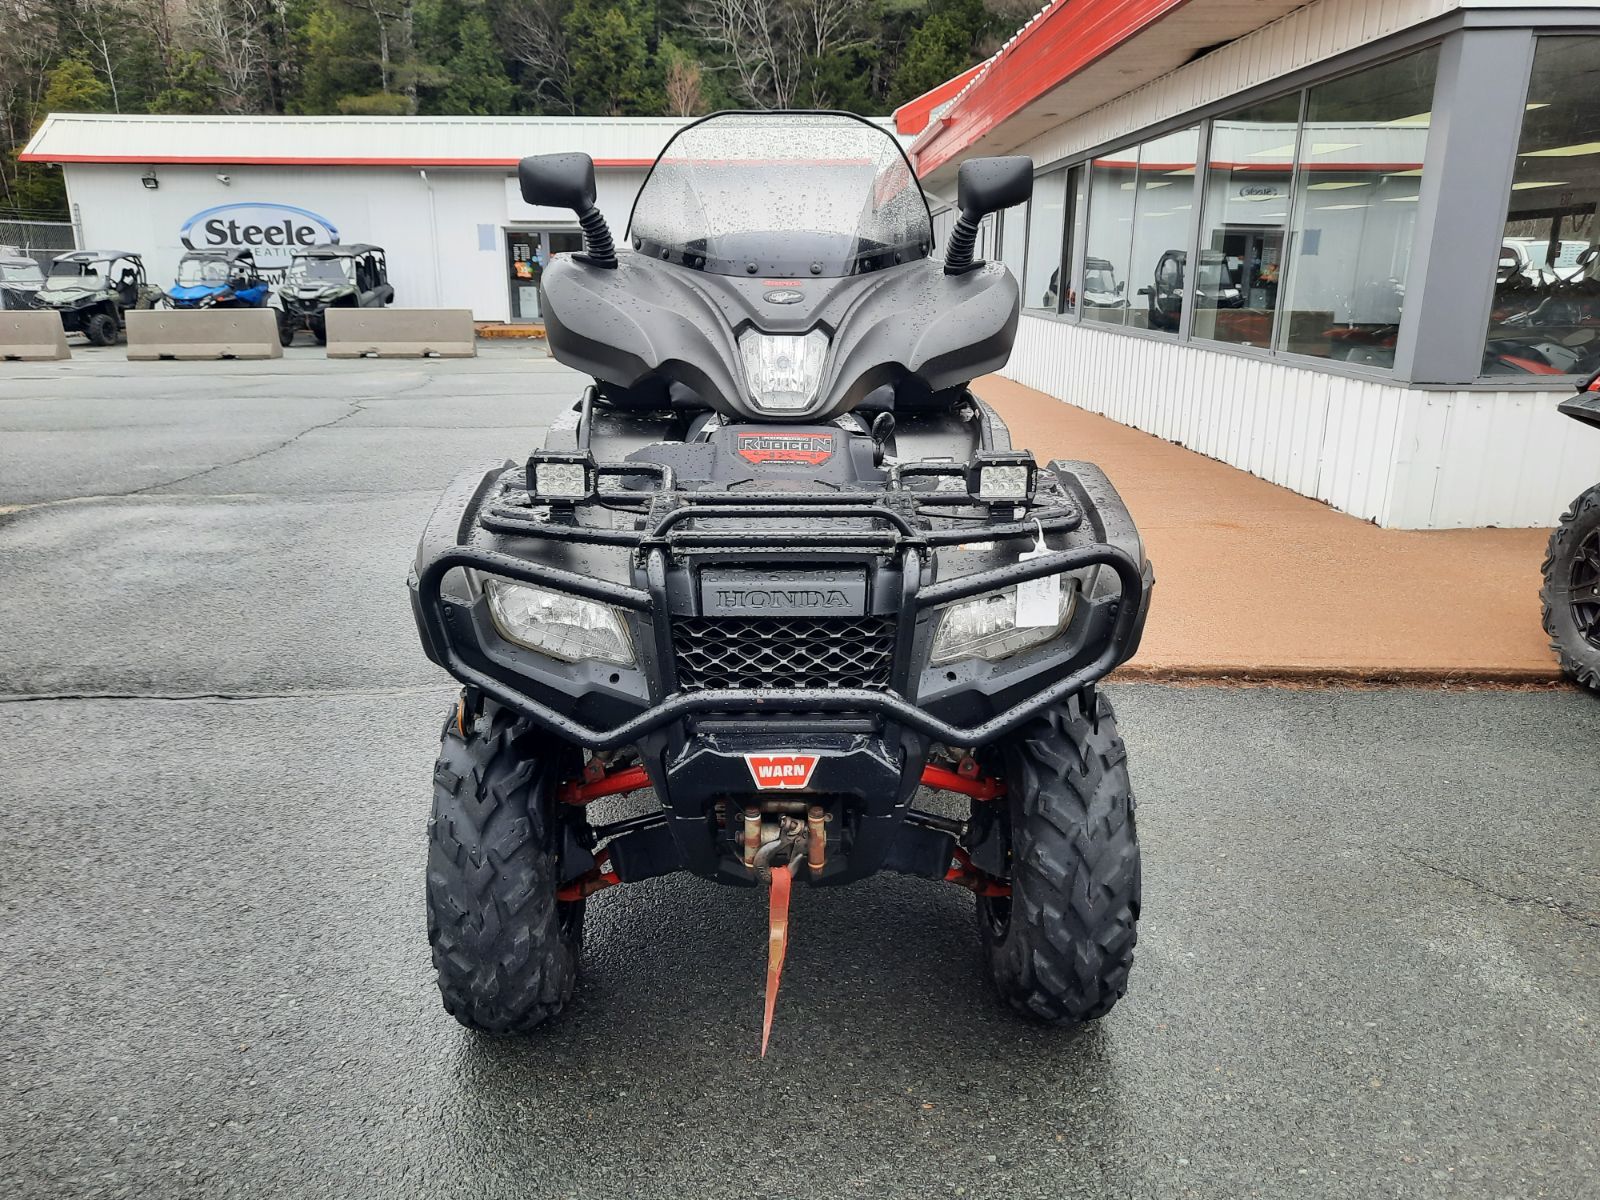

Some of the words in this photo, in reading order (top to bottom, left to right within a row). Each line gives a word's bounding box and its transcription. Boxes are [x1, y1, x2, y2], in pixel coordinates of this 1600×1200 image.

[205, 219, 316, 246] Steele
[737, 436, 832, 453] RUBICON
[716, 590, 852, 609] HONDA
[758, 764, 805, 778] WARN
